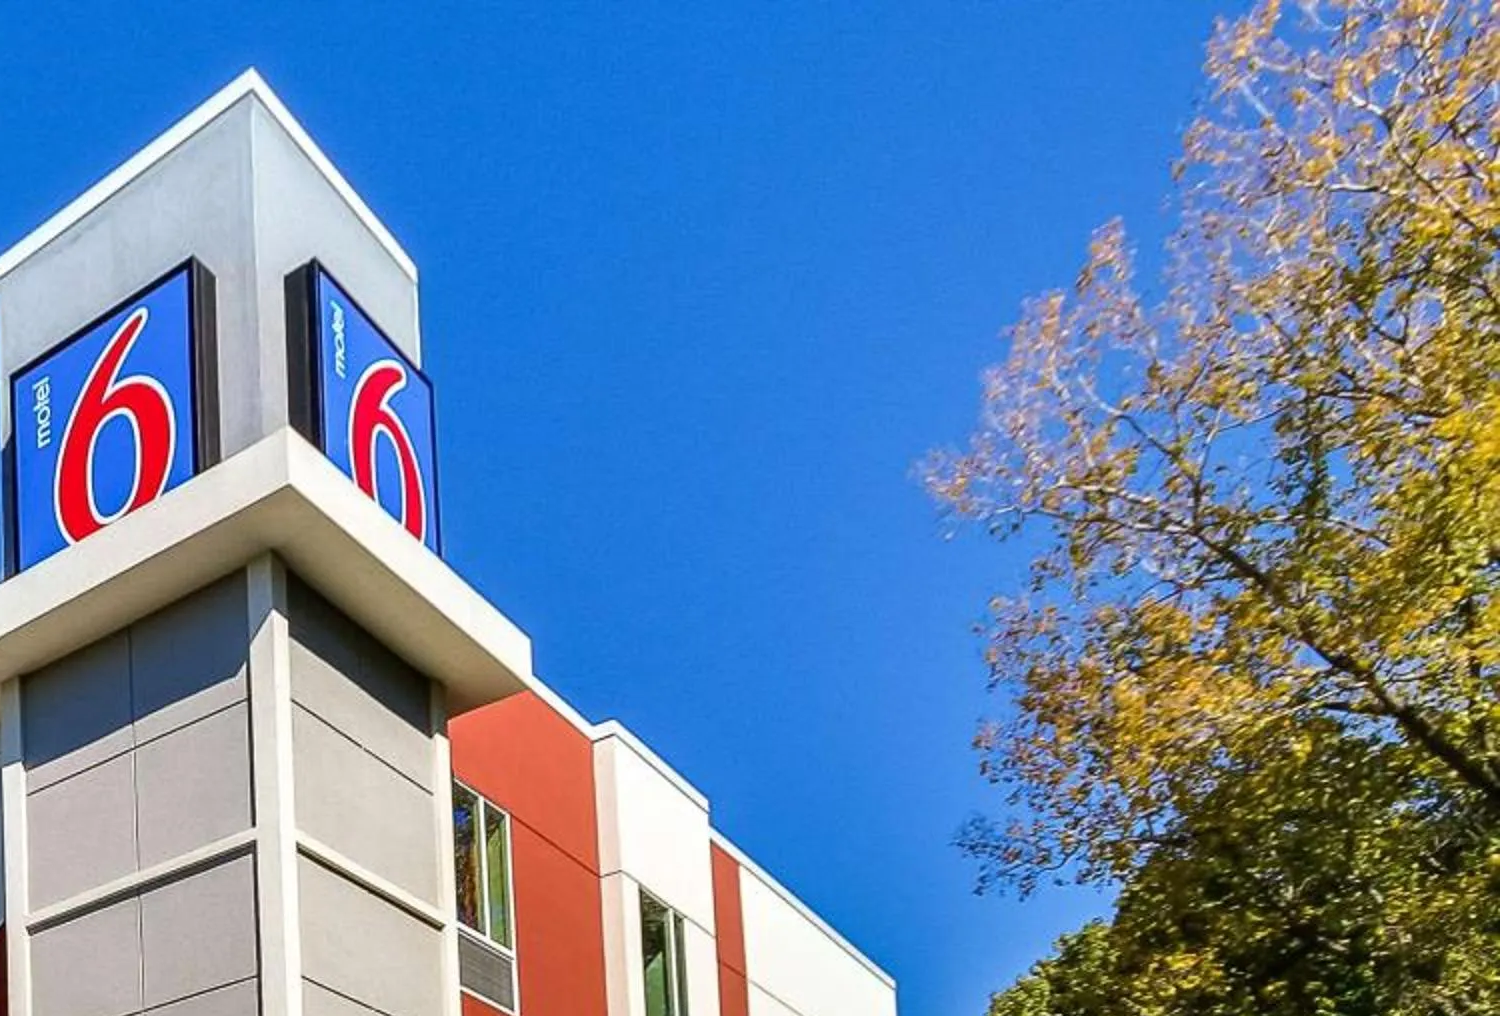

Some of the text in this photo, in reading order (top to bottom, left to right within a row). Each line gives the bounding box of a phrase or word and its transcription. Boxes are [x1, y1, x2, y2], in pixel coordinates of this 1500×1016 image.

[32, 307, 176, 545] motel 6
[330, 301, 426, 544] motel 6
